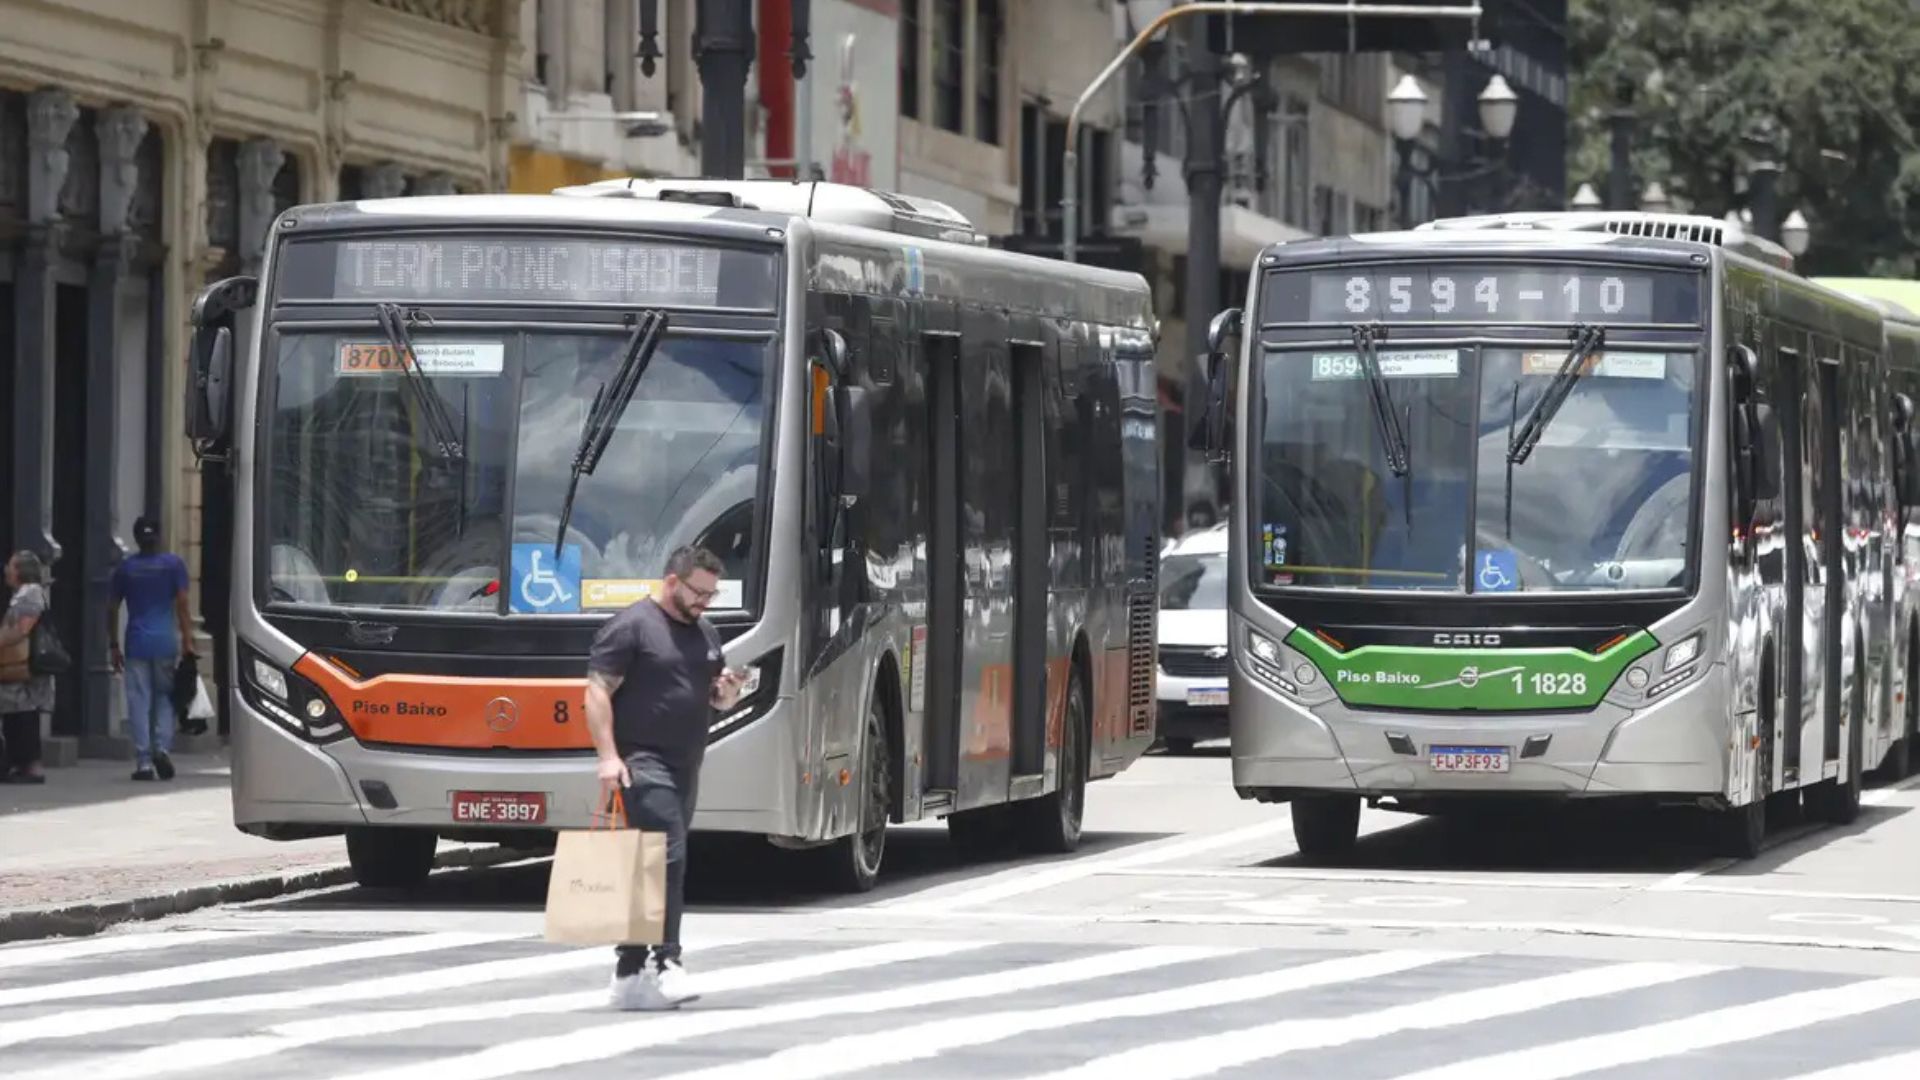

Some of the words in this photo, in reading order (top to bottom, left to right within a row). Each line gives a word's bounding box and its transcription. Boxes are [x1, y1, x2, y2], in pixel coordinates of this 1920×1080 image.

[347, 241, 451, 289] TERM.
[462, 244, 577, 291] PRINC.
[591, 247, 718, 294] ISABEL
[1319, 355, 1362, 376] 859
[1433, 633, 1501, 645] CAIO
[1337, 670, 1371, 683] Piso
[1375, 671, 1420, 684] Baixo
[352, 700, 390, 715] Piso
[396, 702, 448, 717] Baixo
[553, 701, 569, 723] 8
[1436, 754, 1501, 769] FLP3F93
